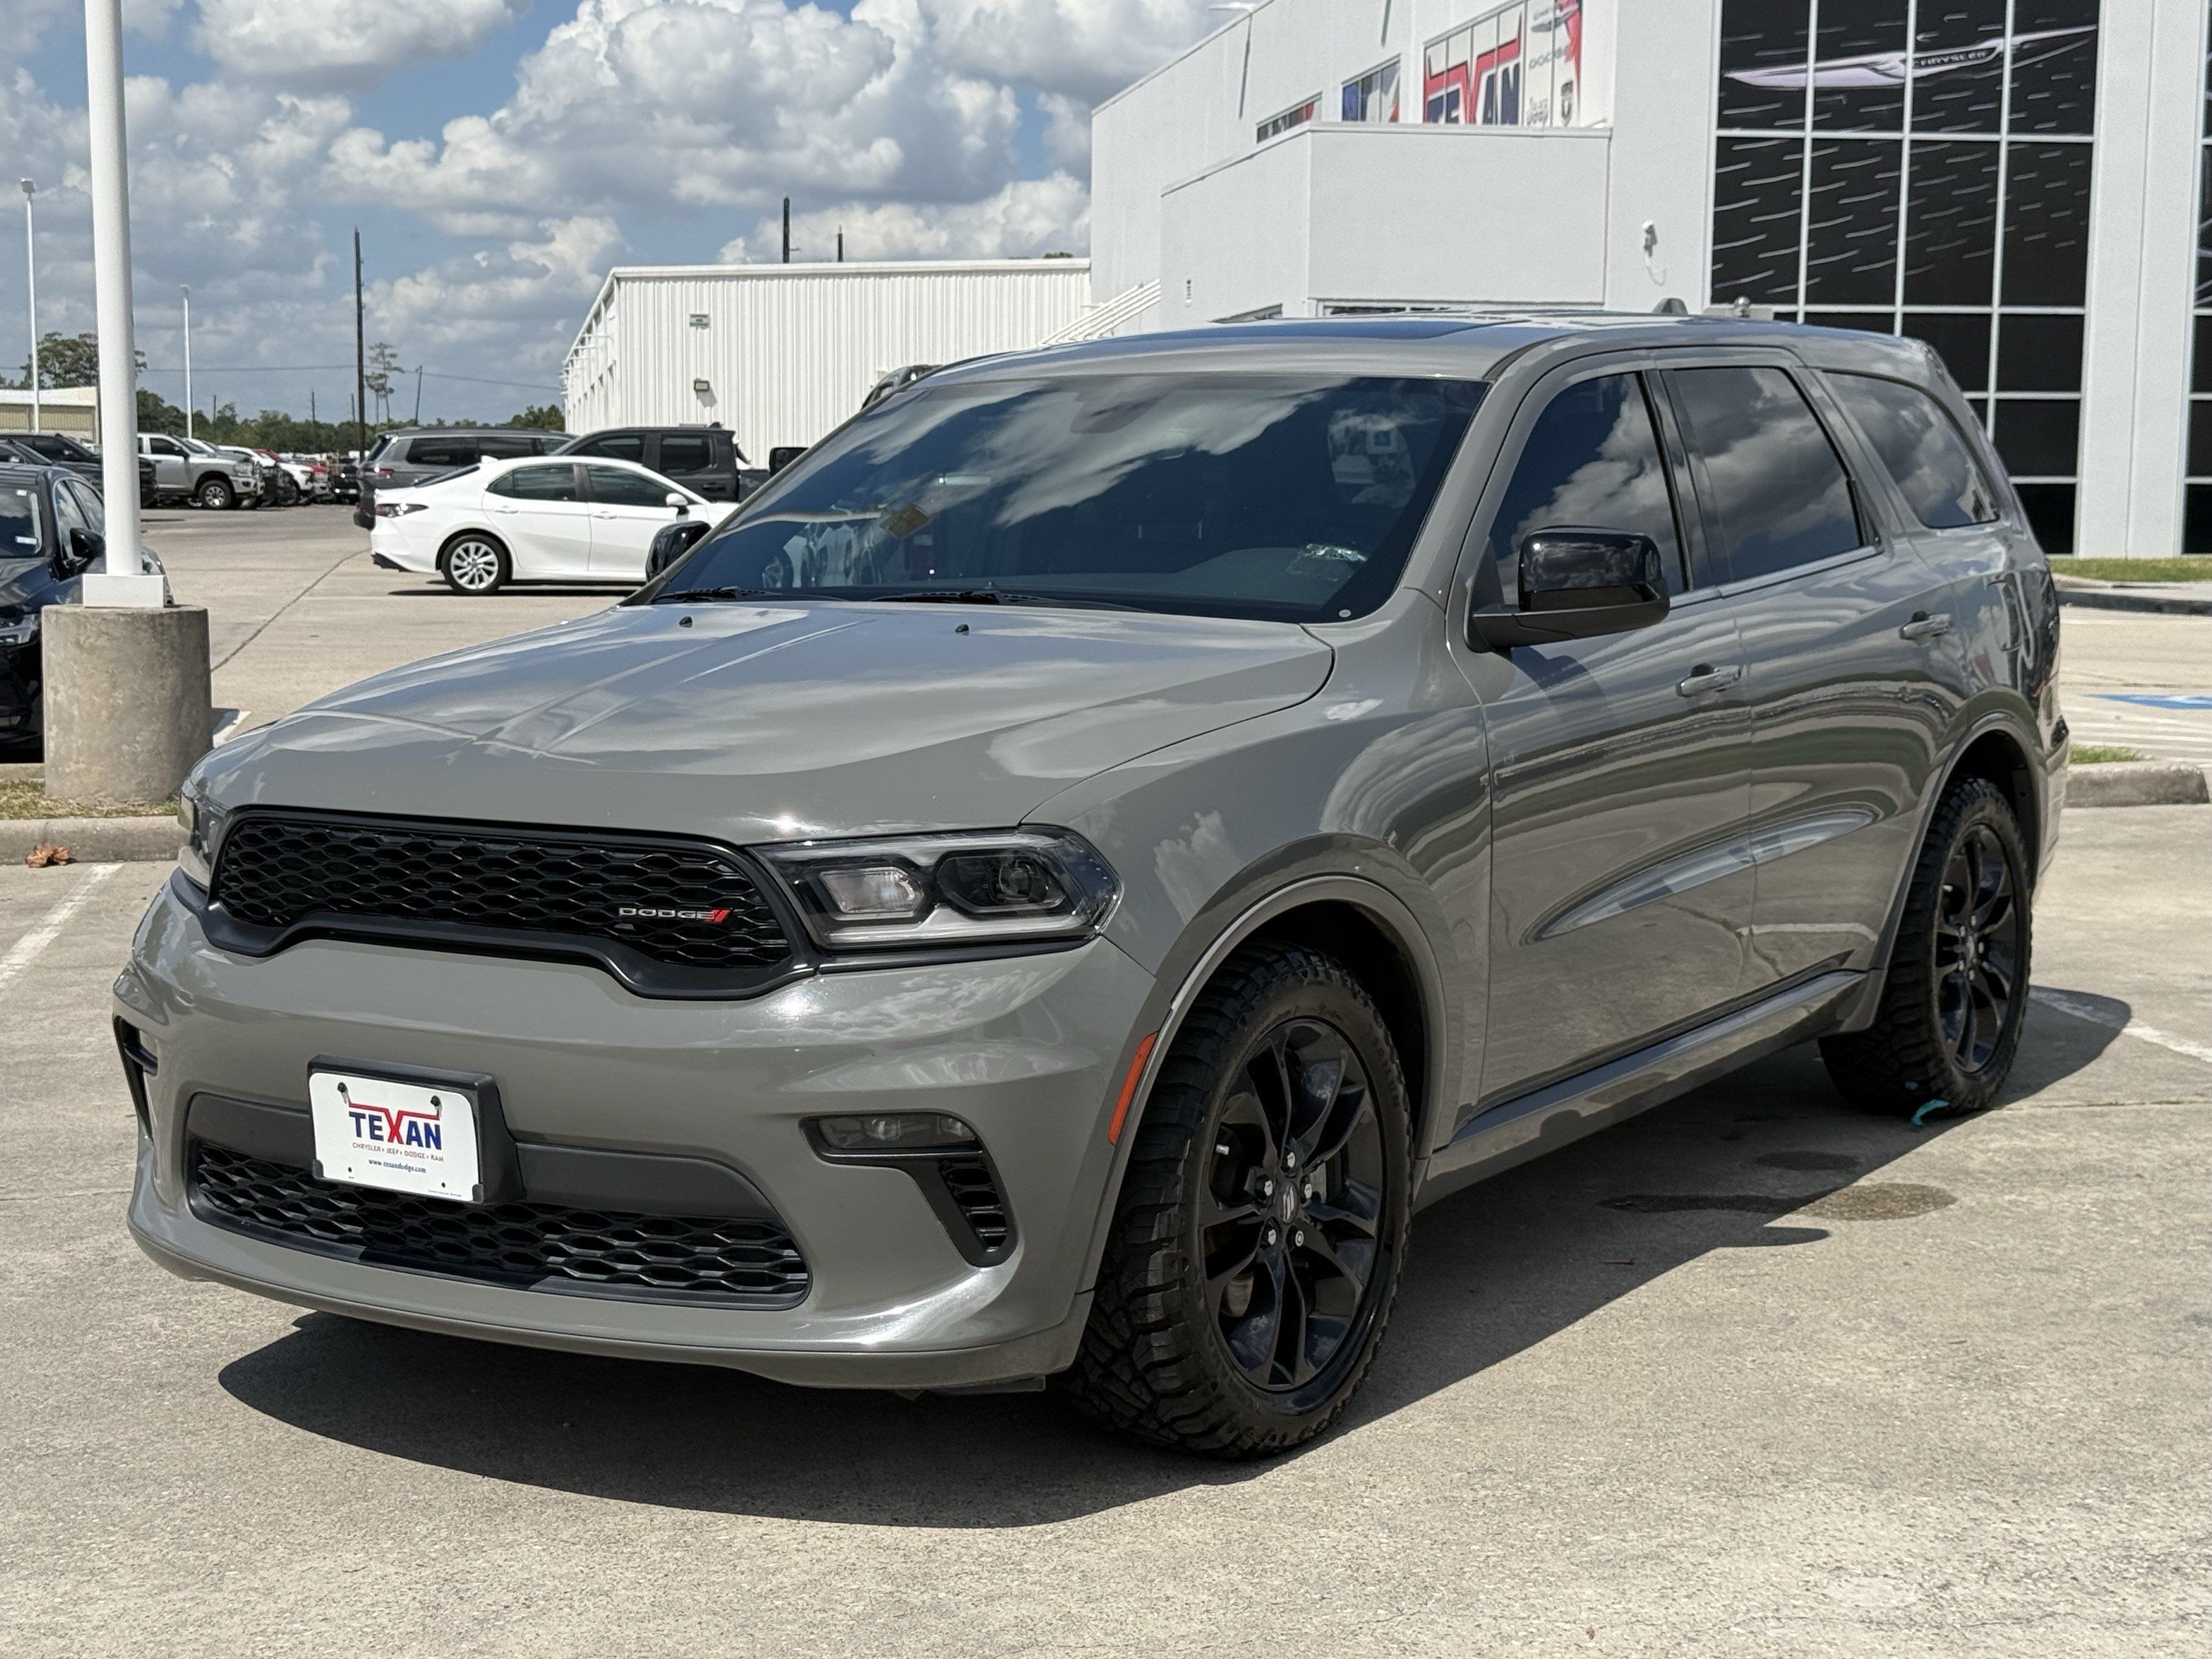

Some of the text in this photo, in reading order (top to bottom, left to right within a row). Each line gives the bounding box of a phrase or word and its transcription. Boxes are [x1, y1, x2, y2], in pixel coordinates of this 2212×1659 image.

[619, 907, 715, 920] DODGE
[348, 1108, 442, 1150] TEXAN
[352, 1142, 381, 1153] CHRYSLER
[404, 1150, 425, 1159] DODGE
